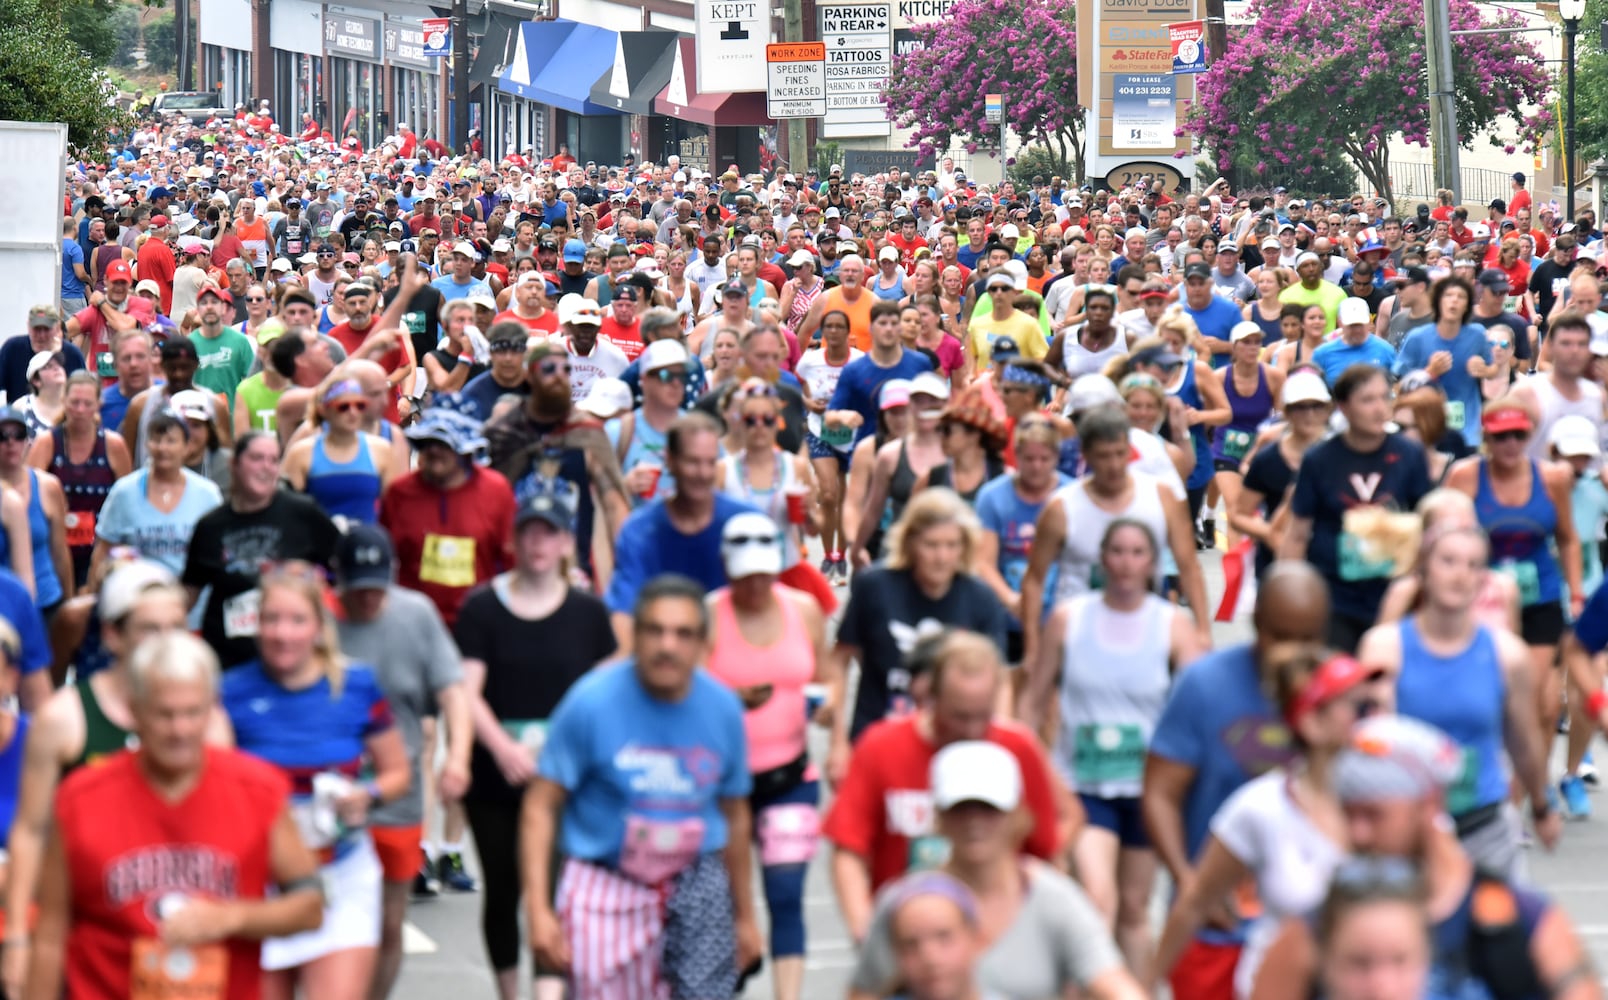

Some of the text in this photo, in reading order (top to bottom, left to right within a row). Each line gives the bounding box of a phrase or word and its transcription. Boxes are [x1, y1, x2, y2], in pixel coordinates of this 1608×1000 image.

[711, 3, 757, 19] KEPT
[824, 7, 887, 19] PARKING
[899, 0, 956, 17] KITCHE
[824, 20, 875, 31] IN REAR
[770, 48, 821, 58] WORK ZONE
[830, 50, 882, 62] TATTOOS
[776, 64, 817, 74] SPEEDING
[826, 65, 887, 76] ROSA FABRICS
[785, 76, 809, 85] FINES
[857, 81, 866, 90] IN
[774, 87, 821, 97] INCREASED
[1118, 87, 1171, 95] 404 231 2232
[833, 96, 858, 106] BOTTOM
[860, 96, 869, 105] OF
[855, 154, 916, 165] PEACHTRE
